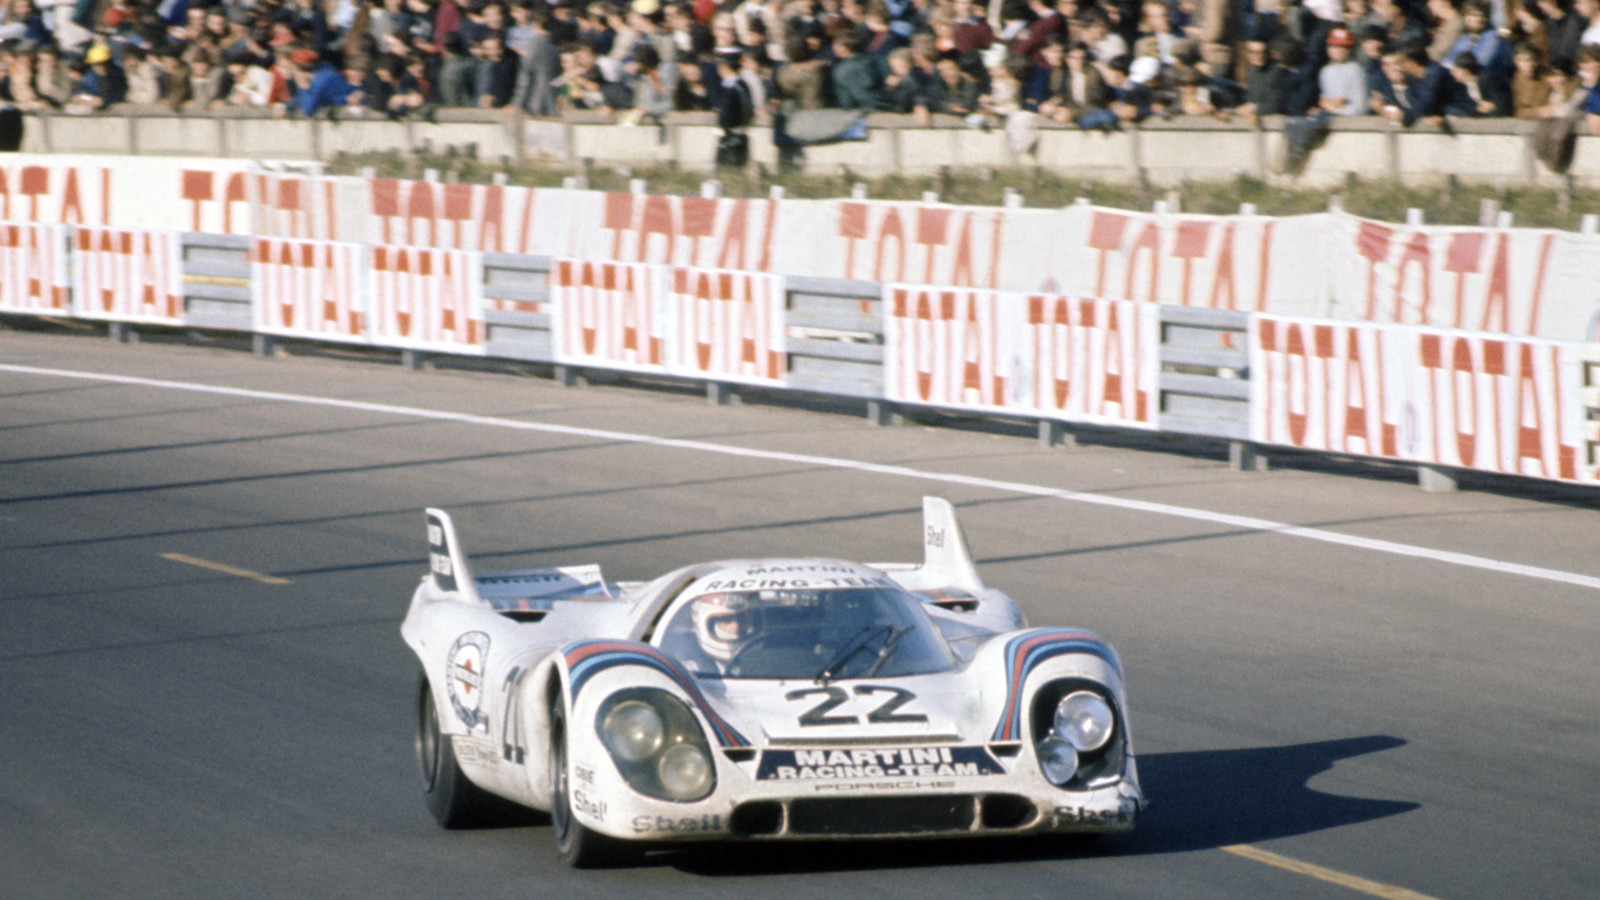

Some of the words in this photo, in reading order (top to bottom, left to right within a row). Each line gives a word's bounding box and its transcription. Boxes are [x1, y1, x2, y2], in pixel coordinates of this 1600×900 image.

[0, 224, 68, 310] TAL
[75, 228, 184, 319] TOTAL
[247, 238, 366, 336] TOTAL
[370, 246, 482, 345] TOTAL
[550, 261, 661, 365] TOTAL
[669, 269, 784, 380] TOTAL
[892, 289, 1005, 407] TOTAL
[1026, 296, 1152, 423] TOTAL
[1257, 318, 1400, 458] TOTAL
[1419, 333, 1578, 479] TOTAL
[785, 685, 929, 727] 22
[795, 747, 953, 766] MARTINI
[814, 781, 956, 792] PORSCHE
[574, 790, 607, 822] Shell
